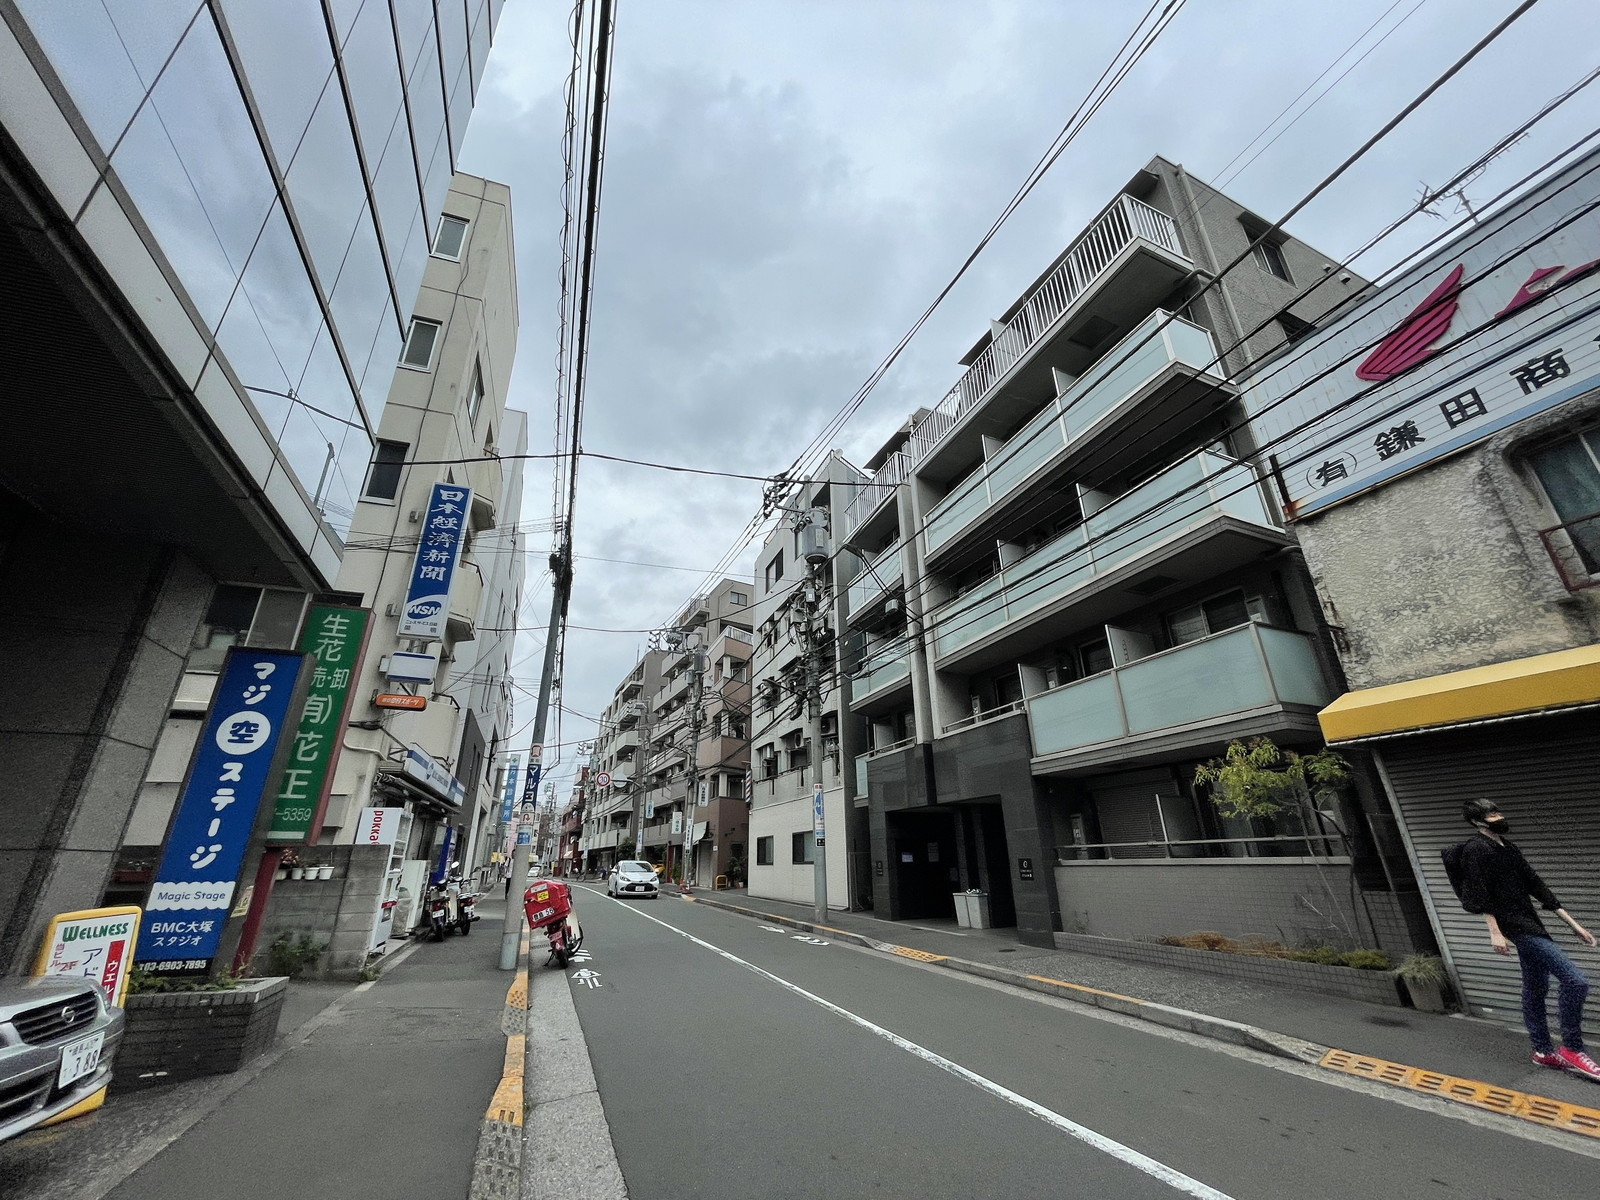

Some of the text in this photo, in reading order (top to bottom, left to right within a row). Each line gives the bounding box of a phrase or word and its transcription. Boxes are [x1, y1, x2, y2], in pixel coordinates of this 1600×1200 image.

[1306, 333, 1600, 490] (有)鎌田商
[408, 604, 441, 616] NSN
[313, 613, 350, 662] 生花
[310, 665, 351, 690] 売・卸
[524, 765, 539, 802] マルヨ
[600, 776, 608, 784] 30
[275, 807, 312, 821] -5359
[157, 891, 226, 902] Magic Stage
[150, 920, 215, 933] BMC大塚
[152, 934, 203, 946] スタジオ
